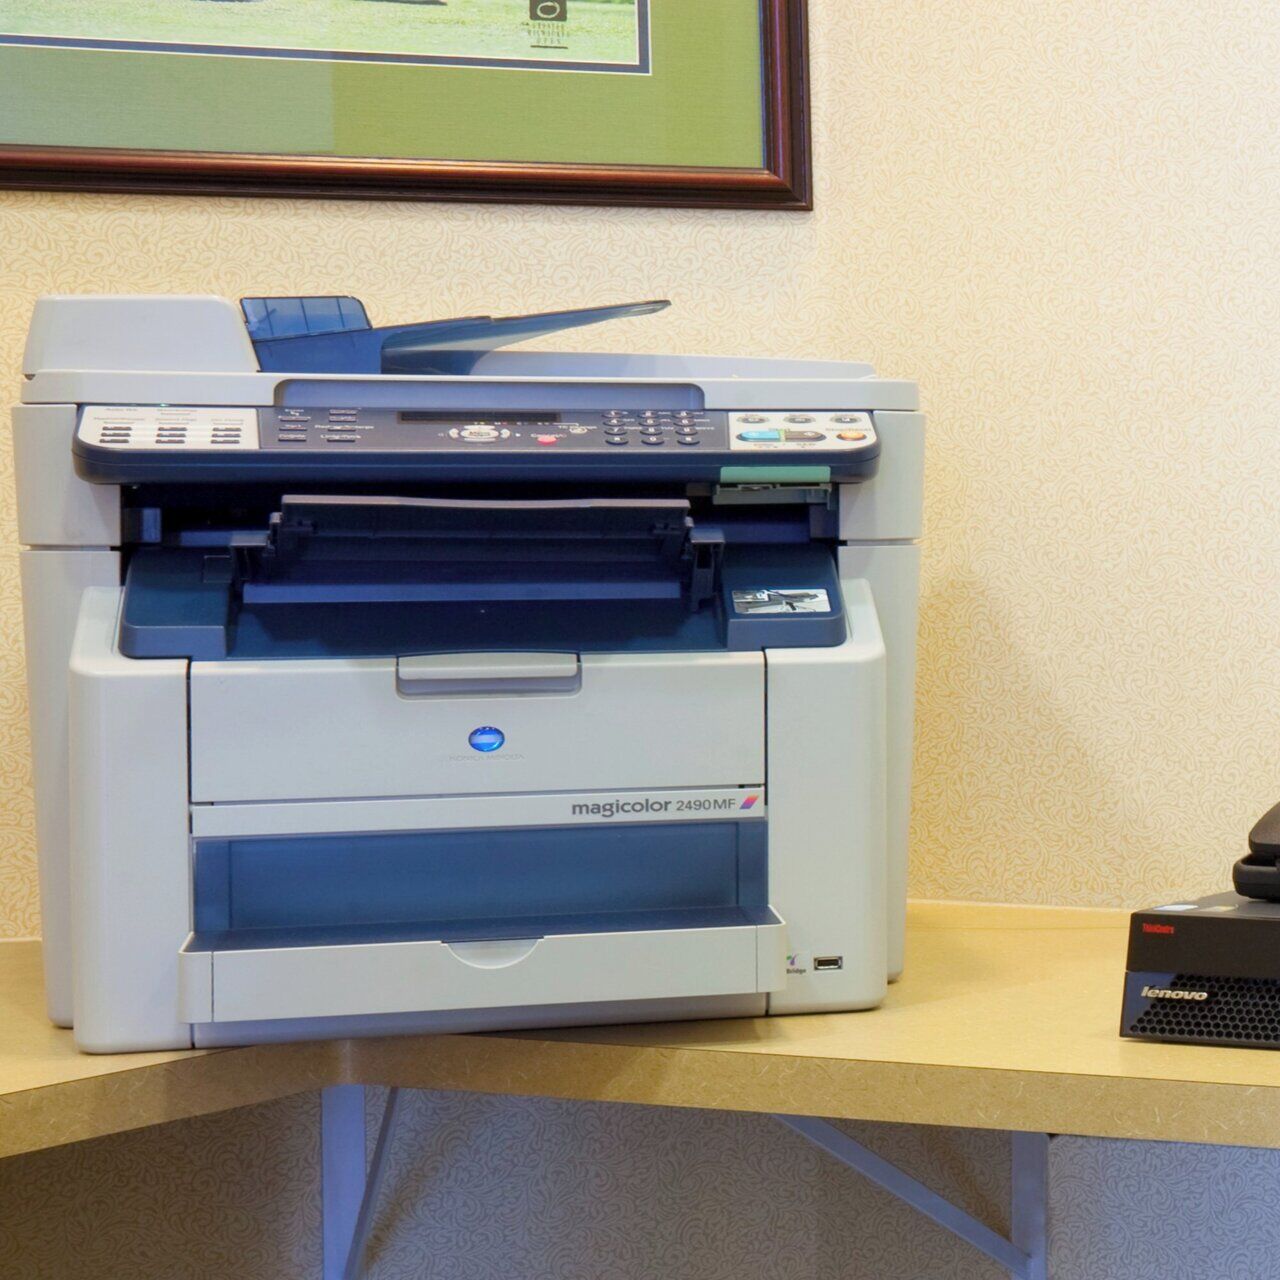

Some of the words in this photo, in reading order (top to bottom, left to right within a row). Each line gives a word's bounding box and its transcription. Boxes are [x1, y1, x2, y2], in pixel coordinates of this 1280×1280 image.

[571, 798, 672, 818] magicolor
[675, 798, 736, 811] 2490MF
[1140, 985, 1208, 1001] lenovo
